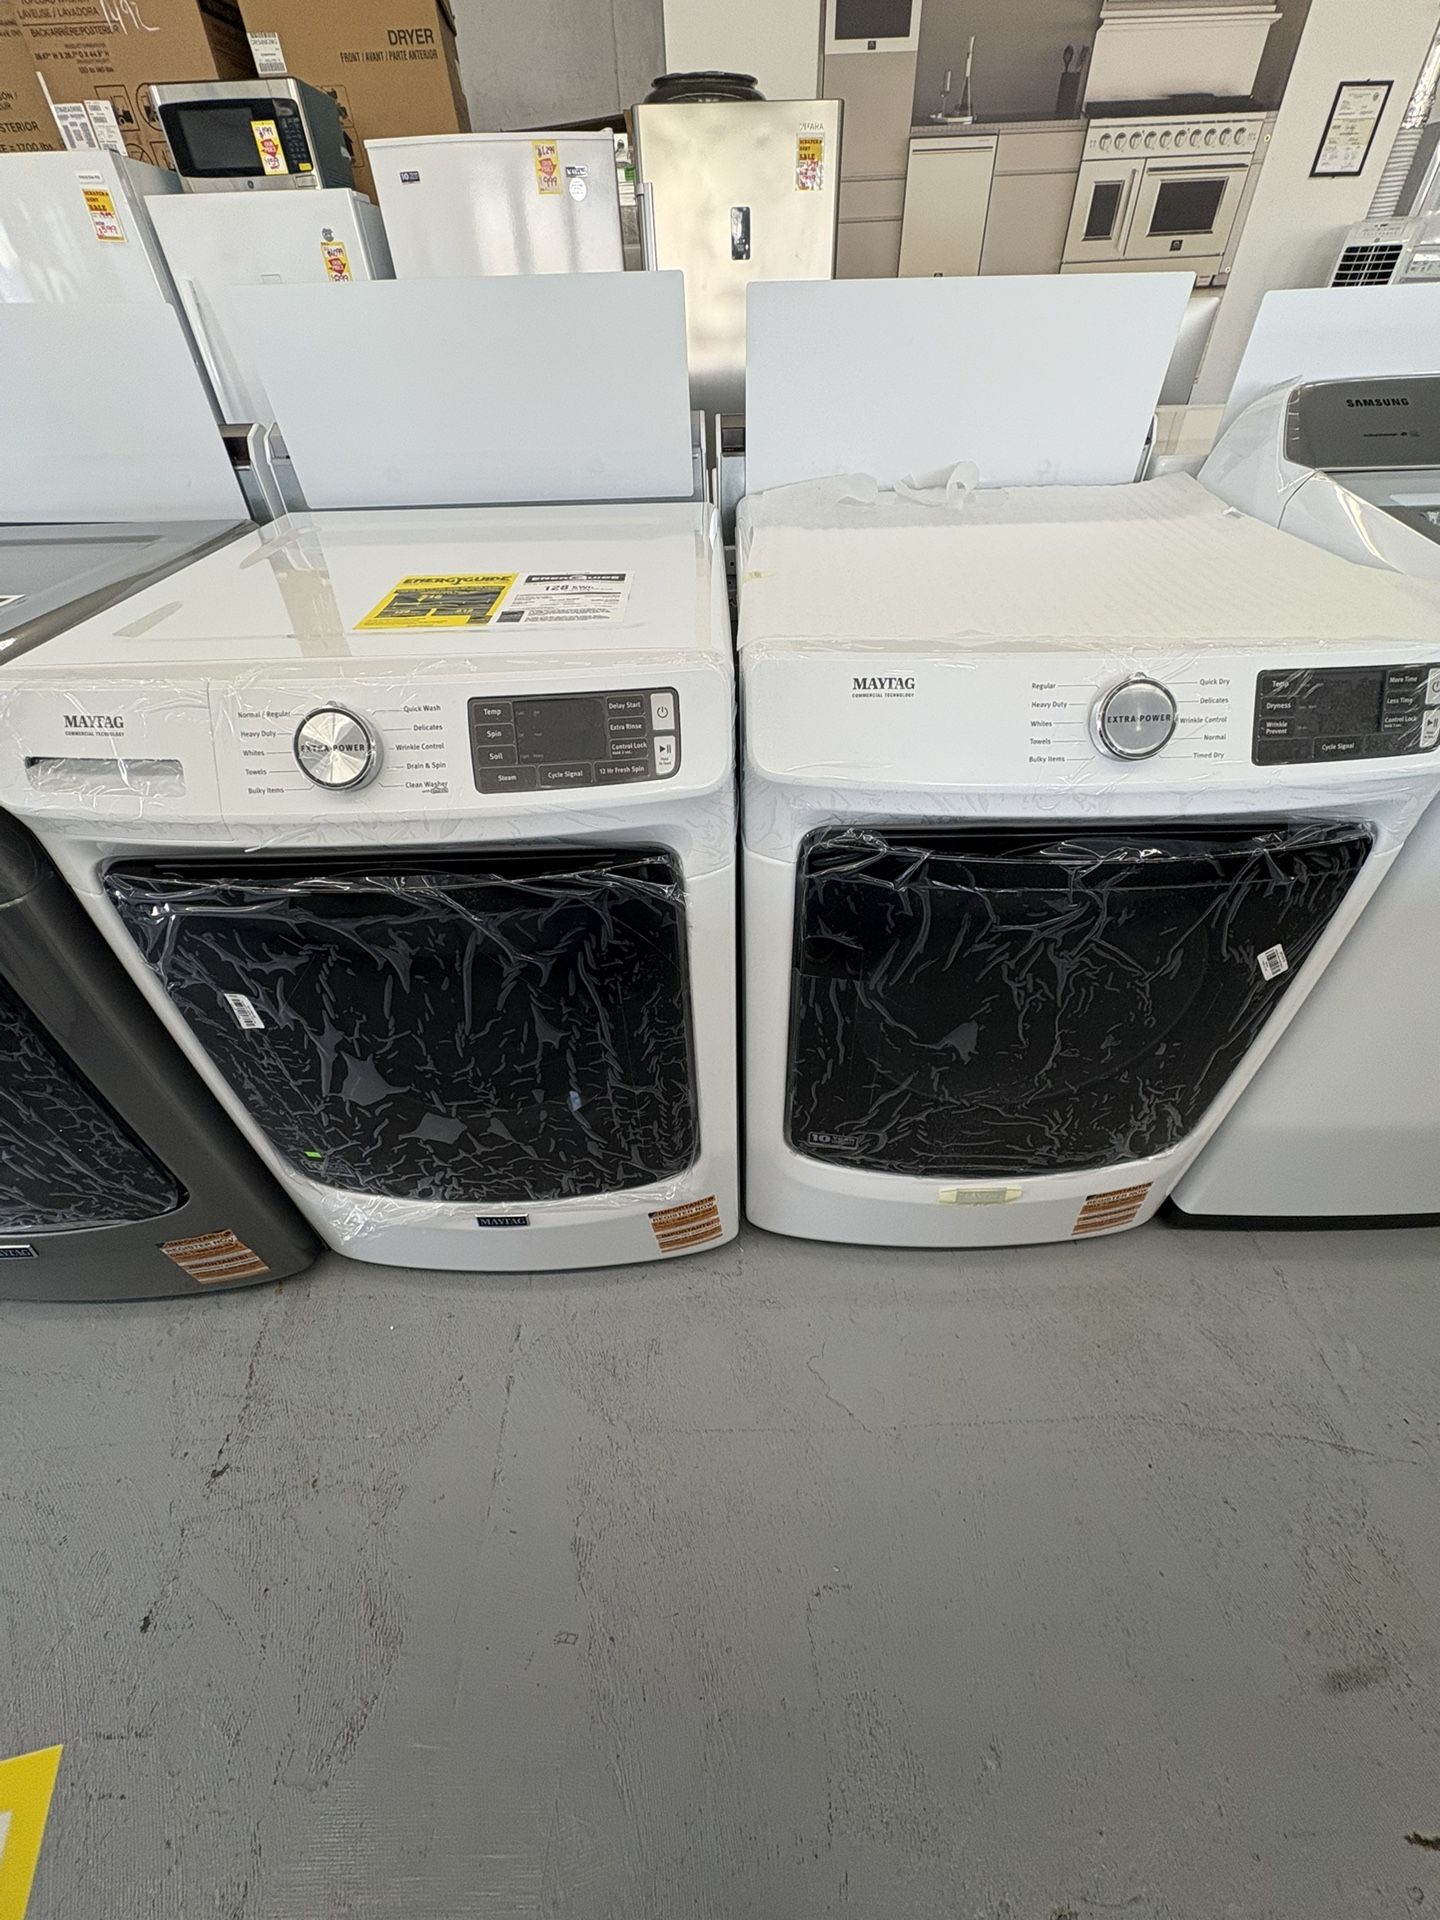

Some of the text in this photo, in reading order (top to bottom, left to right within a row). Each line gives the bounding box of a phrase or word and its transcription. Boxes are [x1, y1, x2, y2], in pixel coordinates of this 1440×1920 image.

[387, 28, 435, 46] DRYER
[340, 51, 361, 63] FRONT
[365, 51, 385, 62] AVANT
[389, 50, 408, 61] PARTE
[408, 49, 439, 60] ANTERIOR
[1346, 398, 1409, 407] SAMSUNG
[853, 677, 915, 690] MAYTAG
[1199, 677, 1231, 686] Quick Dry
[1272, 680, 1289, 688] Temp
[1031, 683, 1056, 691] Regular
[403, 704, 441, 713] Quick Wash
[608, 701, 641, 710] Delay Start
[1031, 701, 1068, 709] Heavy Duty
[1266, 702, 1292, 710] Dryness
[266, 711, 291, 719] Regular
[483, 708, 502, 717] Temp
[63, 715, 125, 729] MAYTAG
[1107, 713, 1171, 723] EXTRA POWER
[1180, 716, 1204, 724] Wrinkle
[609, 722, 642, 731] Extra Rinse
[240, 731, 260, 739] Heavy
[486, 730, 502, 738] Spin
[300, 743, 365, 752] EXTRA POWER
[611, 741, 648, 750] Control Lock
[1321, 742, 1355, 751] Cycle Signal
[242, 749, 265, 757] Whites
[489, 752, 503, 760] Soil
[1212, 751, 1225, 759] Dry
[432, 761, 447, 769] Spin
[615, 766, 631, 774] Fresh
[631, 765, 645, 774] Spin
[497, 774, 517, 782] Steam
[547, 770, 583, 780] Cycle Signal
[422, 780, 448, 788] Washer
[248, 787, 266, 795] Bulky
[812, 1134, 831, 1142] 10
[694, 1201, 714, 1212] NOW
[480, 1217, 526, 1226] MAYTAG
